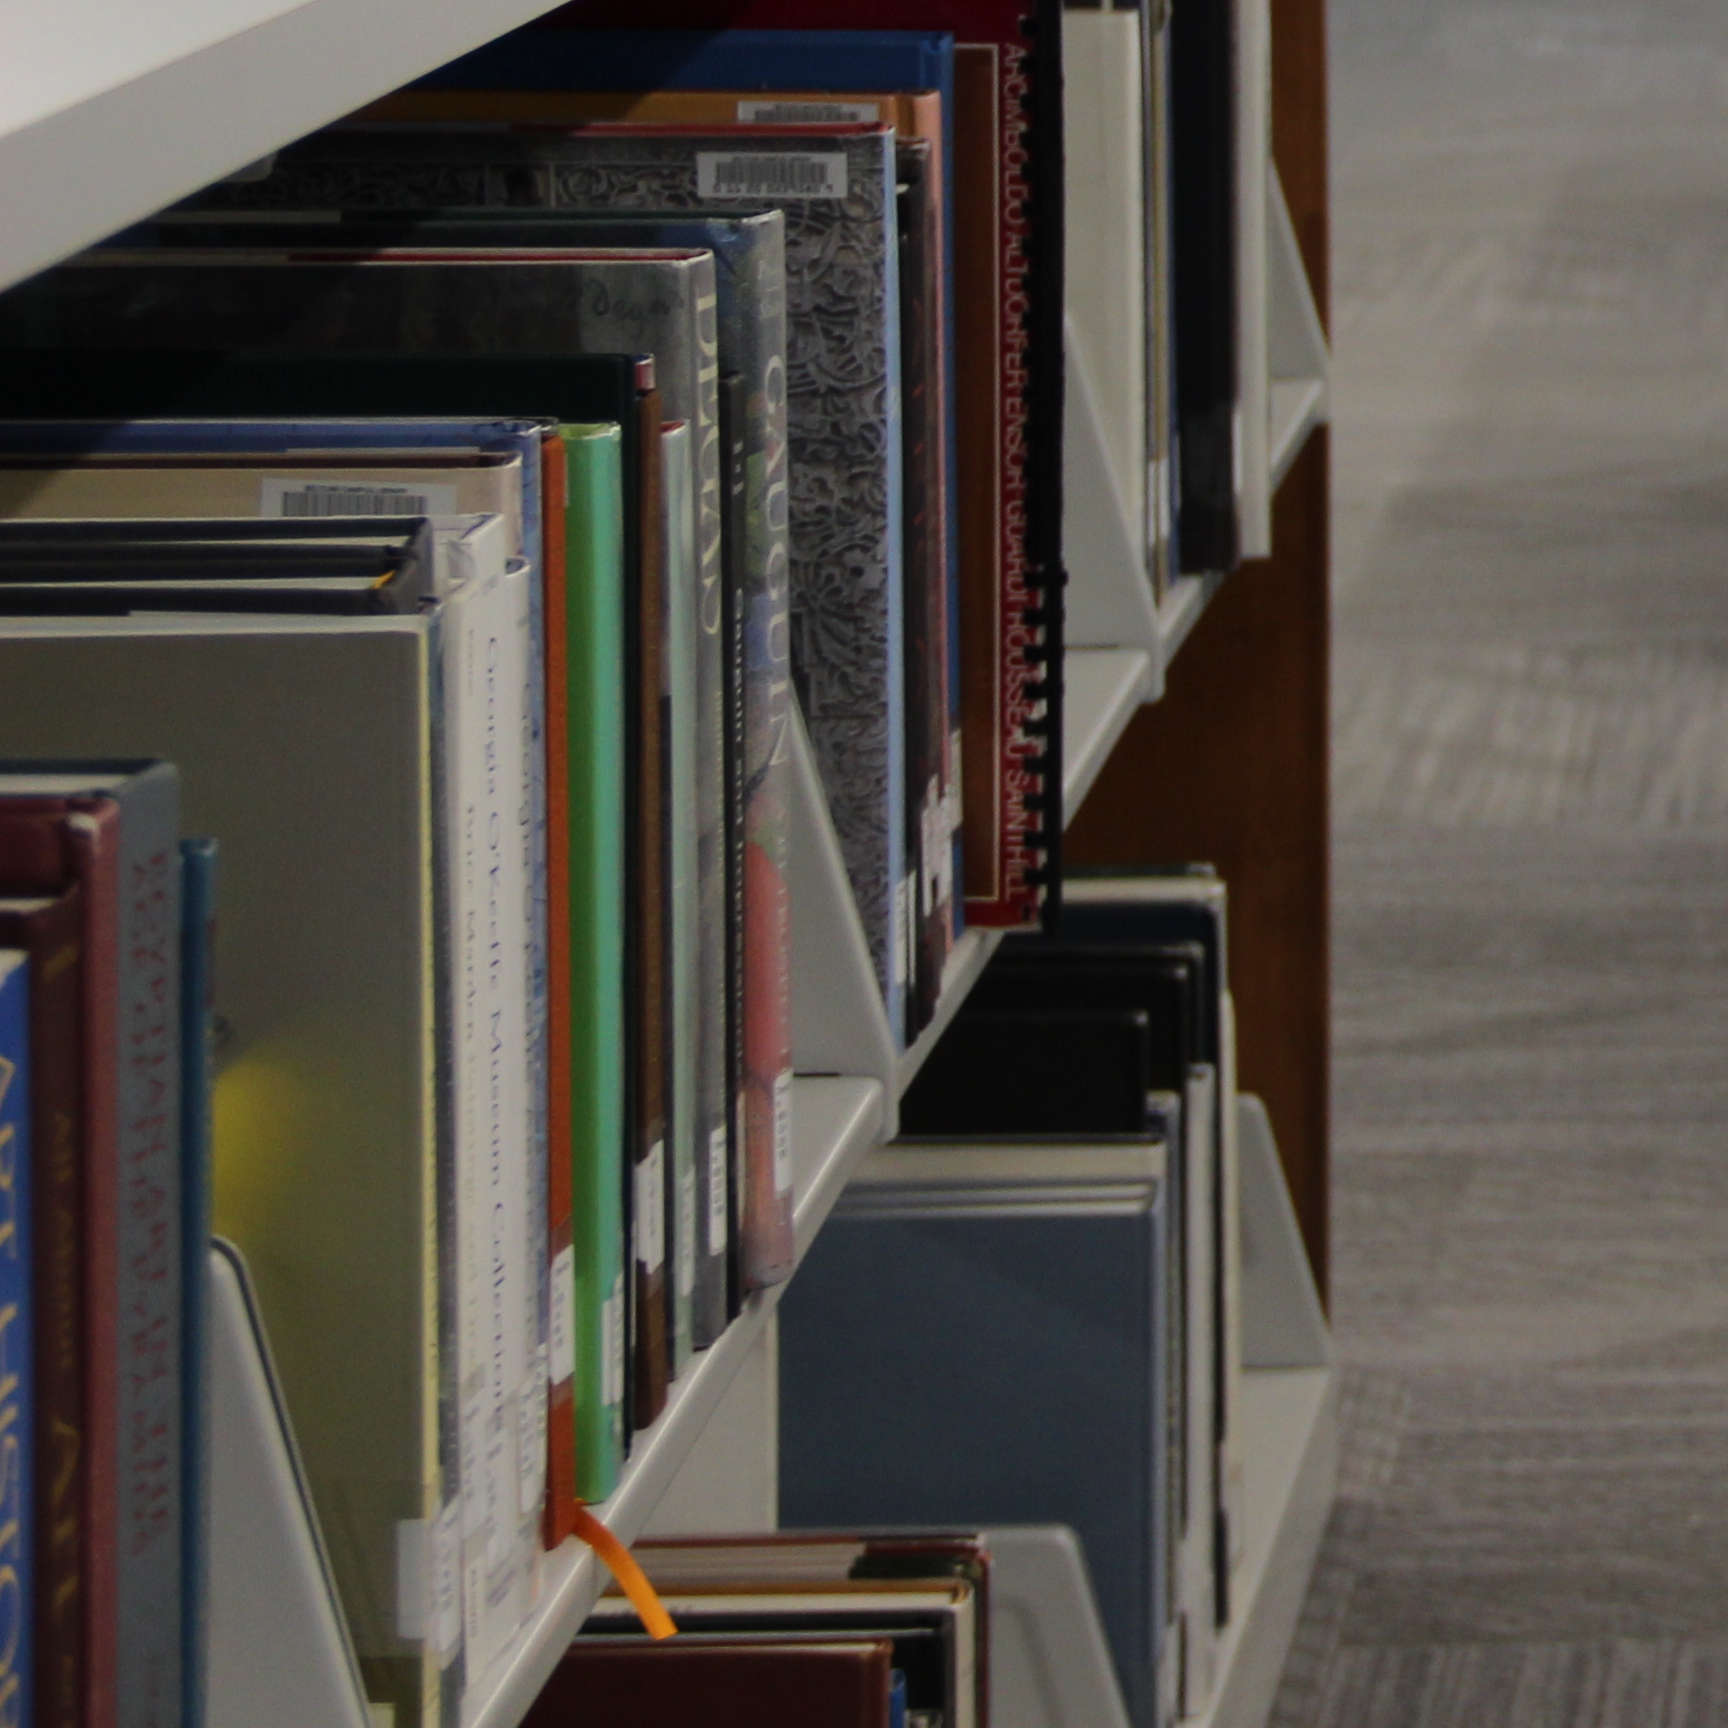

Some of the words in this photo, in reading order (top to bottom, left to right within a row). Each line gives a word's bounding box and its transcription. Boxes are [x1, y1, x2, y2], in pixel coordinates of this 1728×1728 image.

[764, 353, 790, 769] GAUGUIN
[484, 635, 501, 794] Georgia
[487, 809, 502, 991] O'Keeffe
[490, 1008, 503, 1187] Museum
